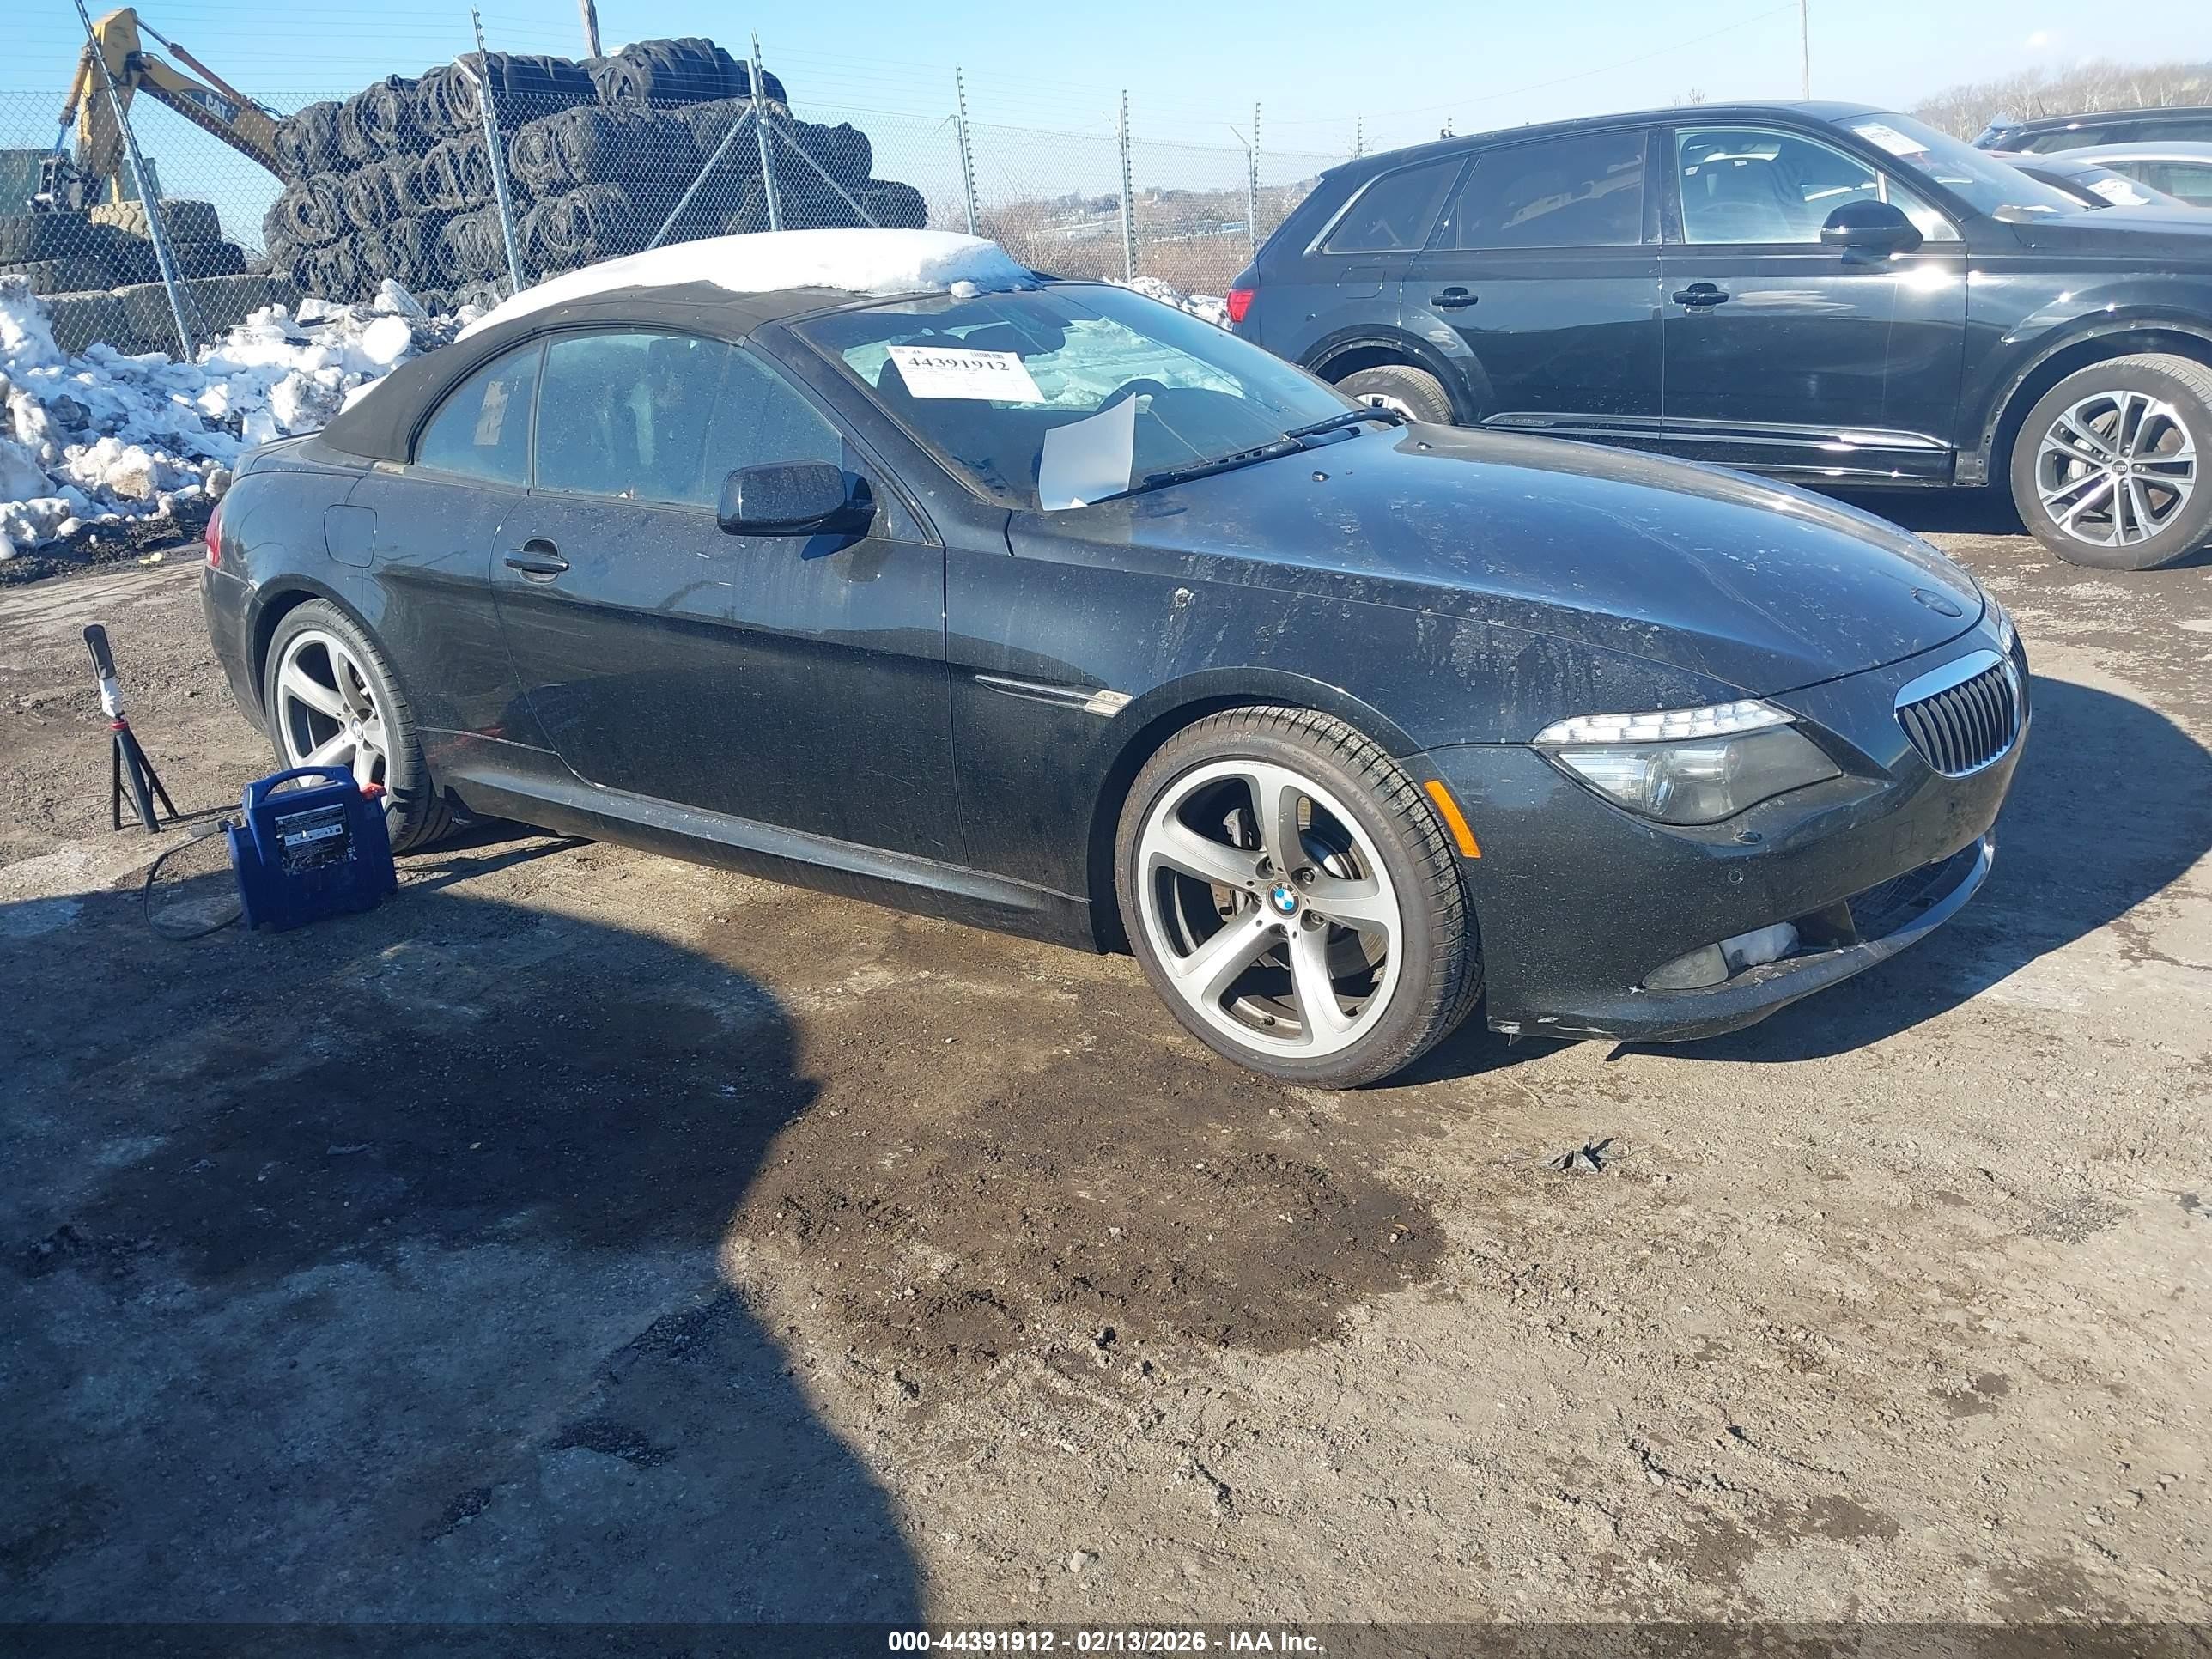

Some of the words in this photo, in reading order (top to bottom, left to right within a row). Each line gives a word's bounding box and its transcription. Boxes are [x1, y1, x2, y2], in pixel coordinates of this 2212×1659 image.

[205, 93, 228, 118] CAT
[908, 357, 1010, 371] 44391912
[1272, 883, 1298, 897] BMW
